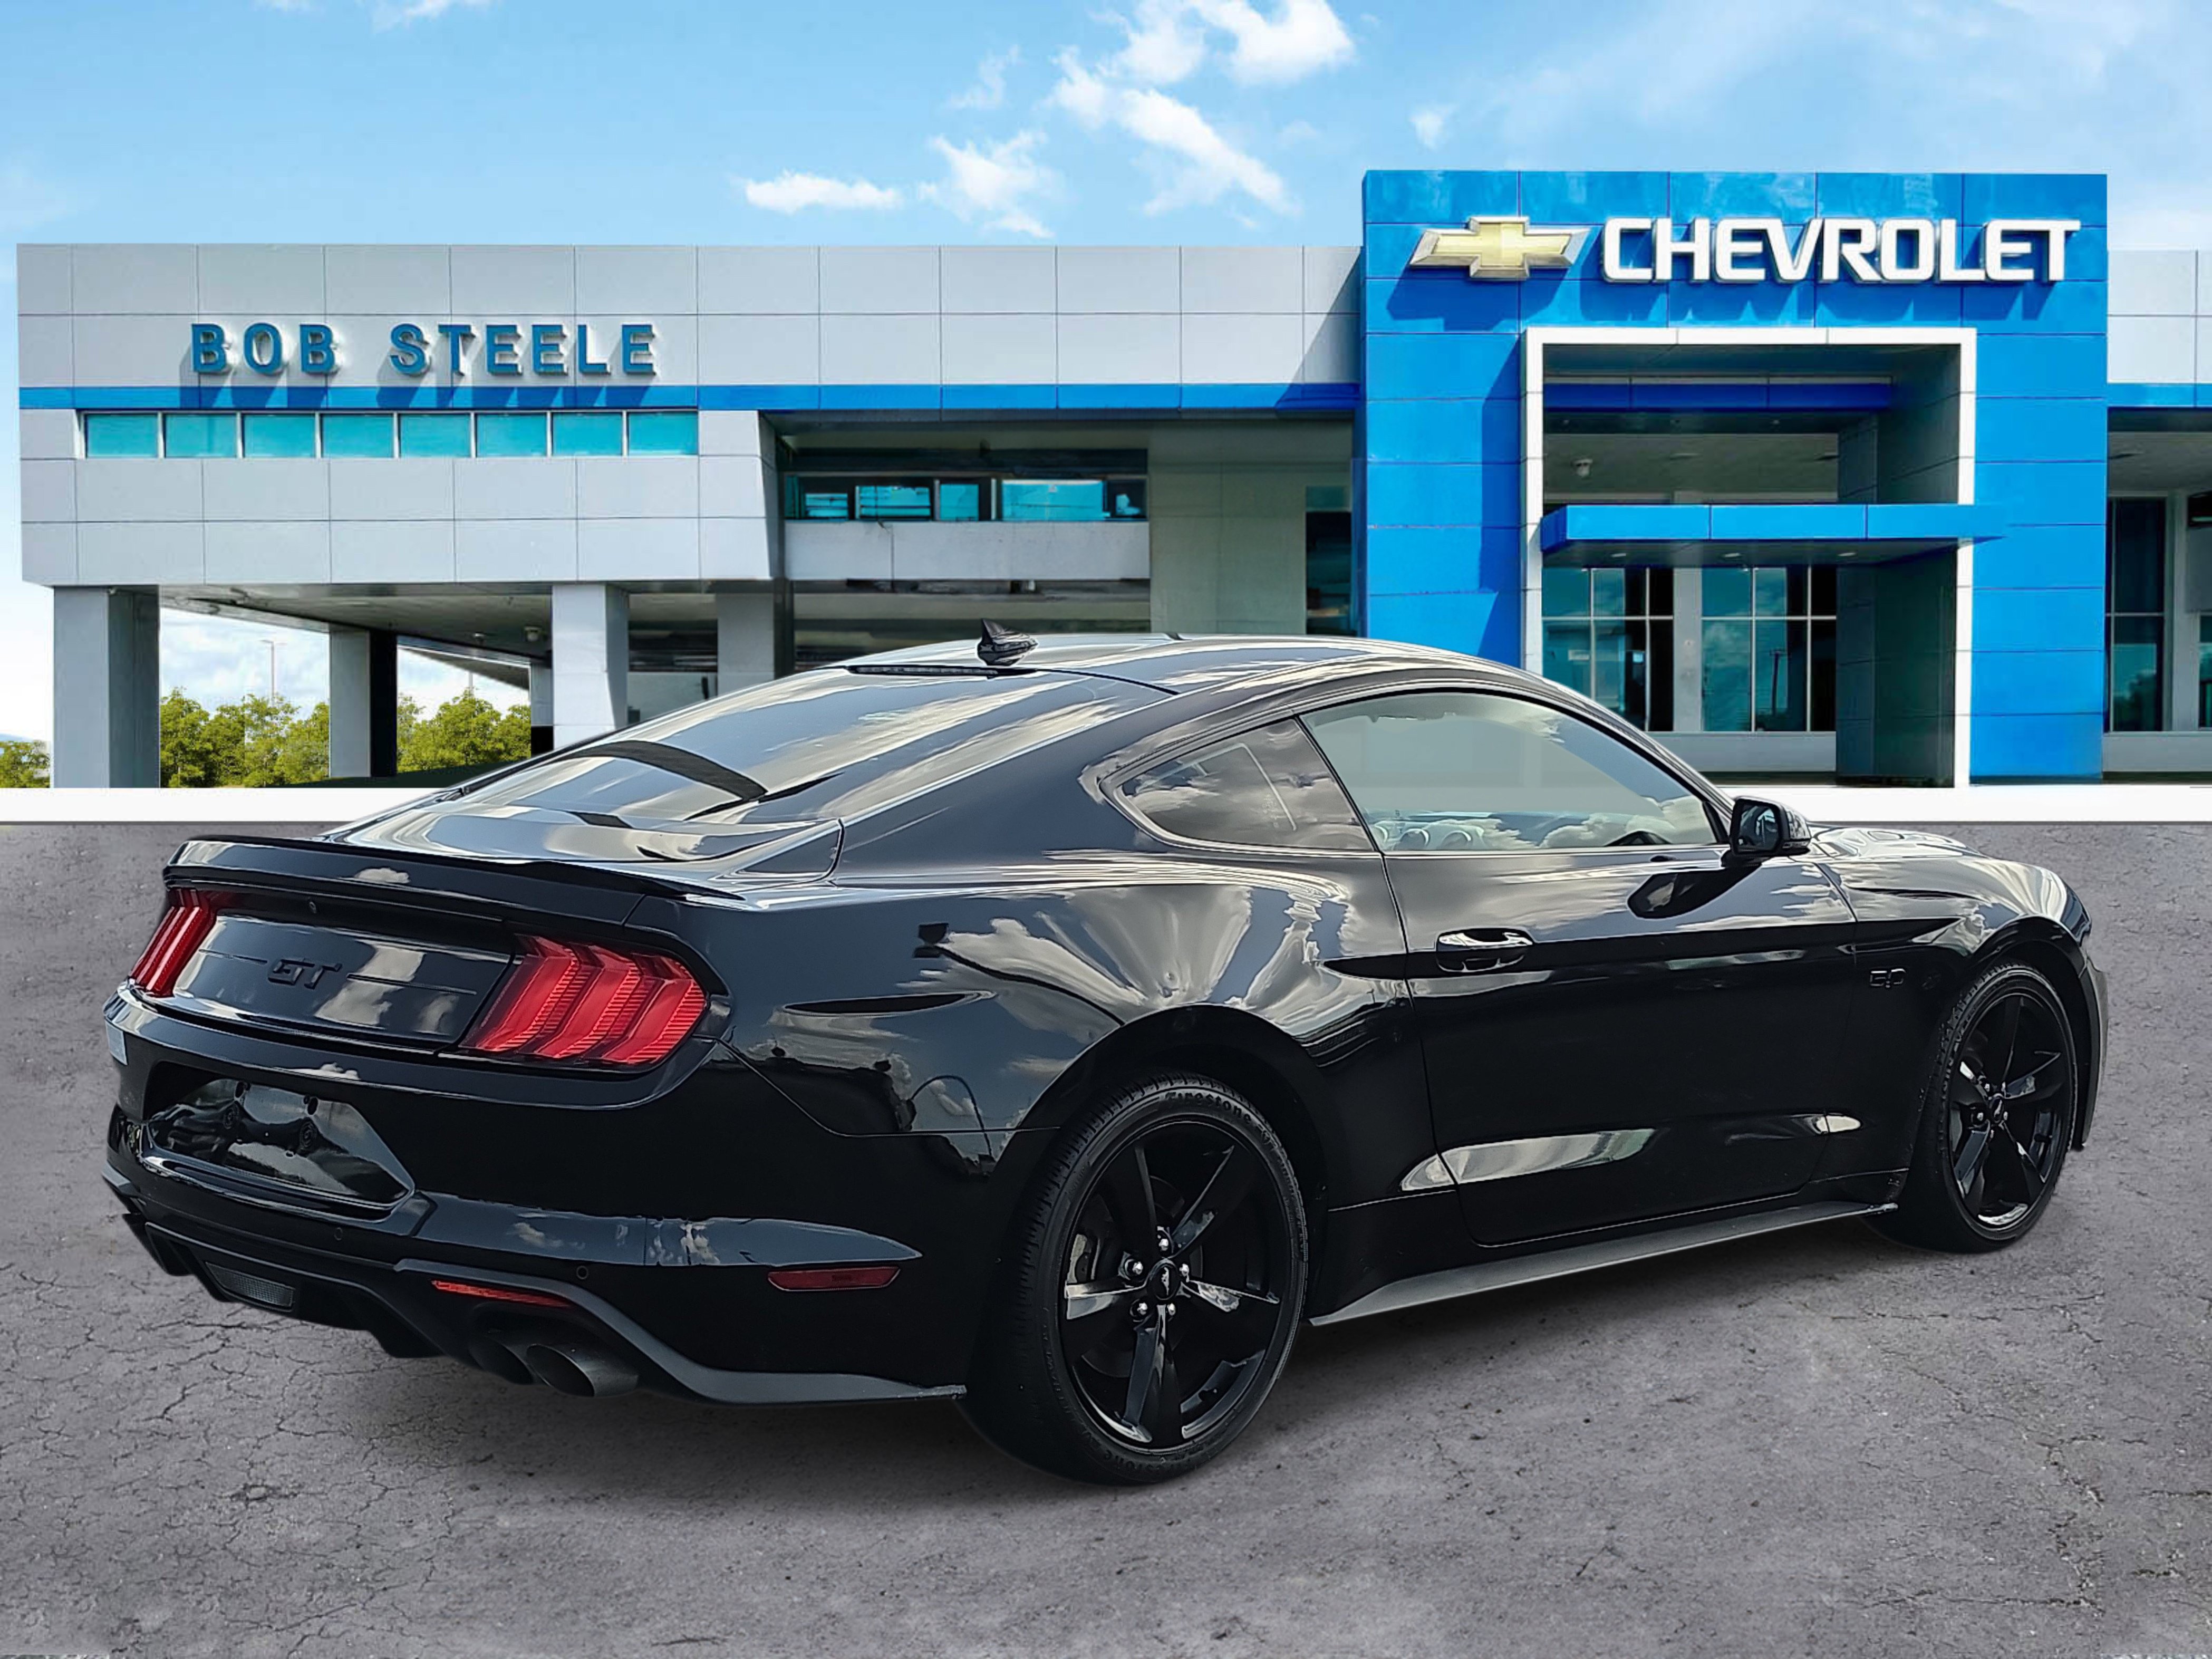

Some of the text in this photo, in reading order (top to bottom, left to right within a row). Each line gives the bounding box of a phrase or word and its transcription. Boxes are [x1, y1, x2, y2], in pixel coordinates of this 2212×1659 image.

[1601, 217, 2080, 283] CHEVROLET
[191, 322, 657, 377] BOB STEELE
[268, 958, 342, 990] GT
